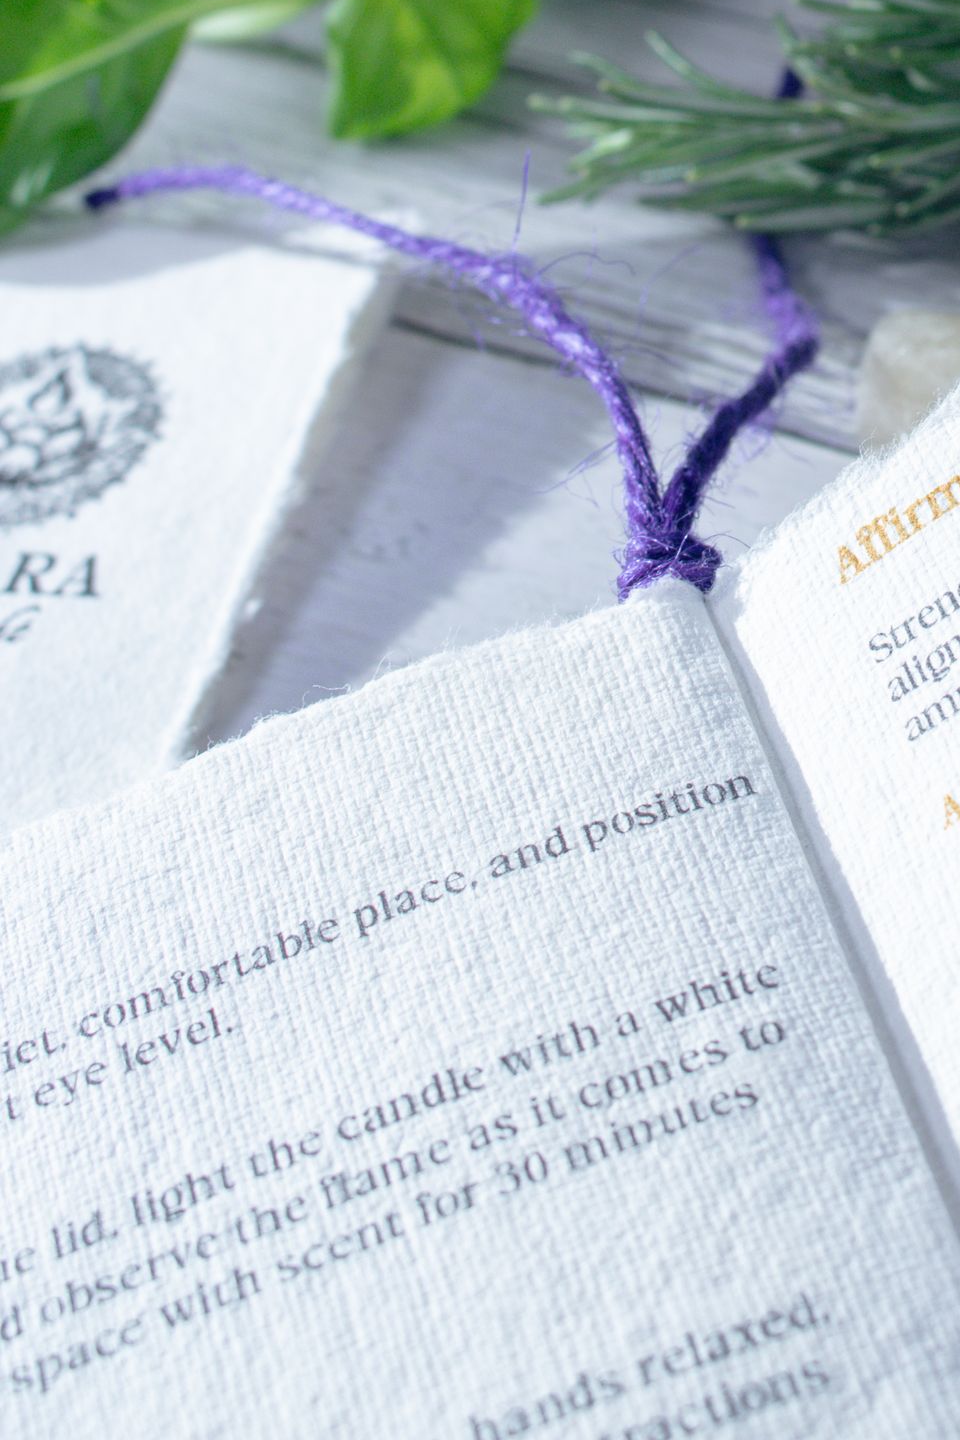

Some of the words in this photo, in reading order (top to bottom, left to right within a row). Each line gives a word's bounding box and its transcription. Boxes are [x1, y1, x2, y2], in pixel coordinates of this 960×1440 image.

[79, 917, 339, 1039] comfortable
[489, 826, 572, 879] and
[583, 773, 758, 853] position
[34, 1061, 108, 1107] eye
[121, 1007, 234, 1075] level.
[40, 1231, 219, 1325] observe
[234, 1193, 310, 1246] the
[319, 1137, 454, 1210] flame
[468, 1112, 518, 1153] as
[529, 1091, 567, 1128] it
[578, 1036, 729, 1110] comes
[739, 1019, 786, 1053] to
[130, 1162, 237, 1228] light
[248, 1129, 323, 1179] the
[336, 1066, 487, 1143] candle
[499, 1020, 601, 1078] with
[615, 1010, 640, 1038] a
[653, 963, 781, 1024] white
[8, 1312, 146, 1394] space
[159, 1265, 262, 1330] with
[276, 1211, 406, 1281] scent
[416, 1180, 480, 1227] for
[495, 1150, 549, 1197] 30
[563, 1080, 760, 1172] minutes
[468, 1372, 628, 1440] hands
